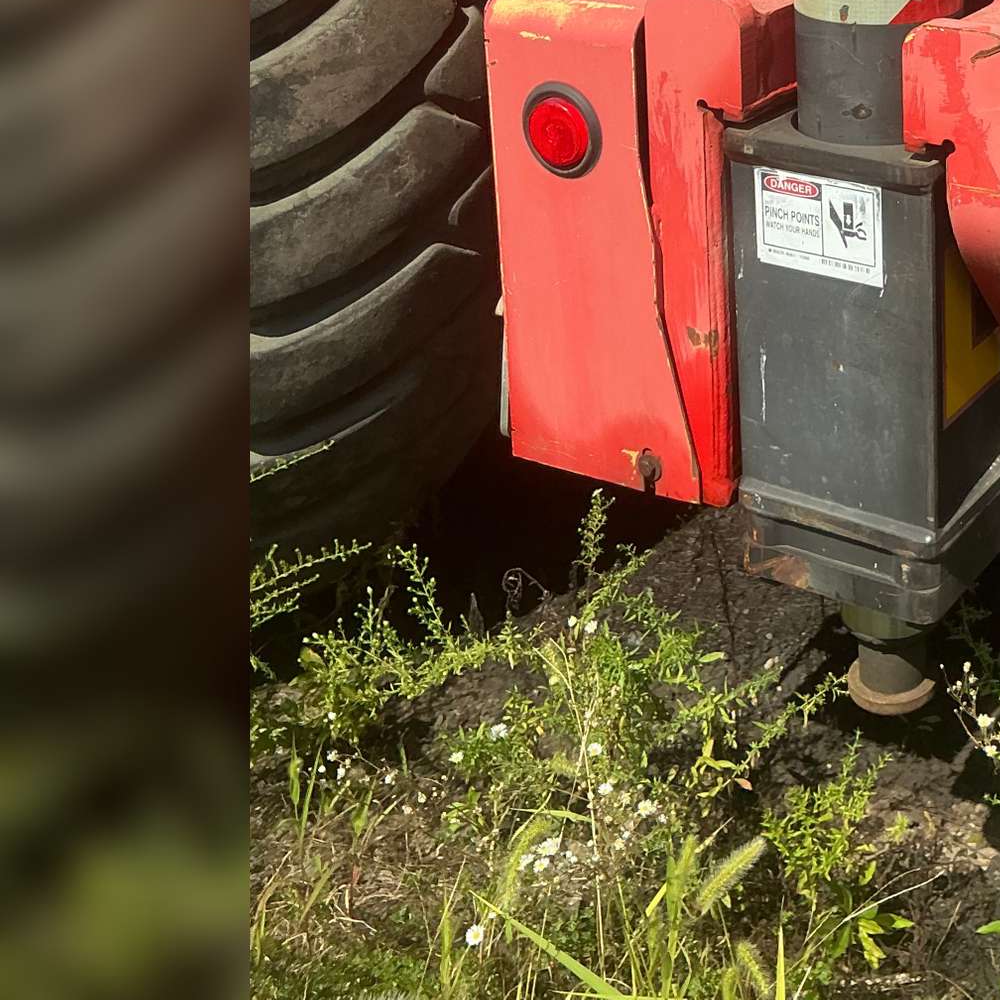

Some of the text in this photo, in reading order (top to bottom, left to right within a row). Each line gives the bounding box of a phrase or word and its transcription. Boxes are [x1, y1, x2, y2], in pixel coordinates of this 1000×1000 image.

[770, 177, 813, 196] DANGER
[765, 205, 821, 227] PINCH POINTS
[766, 222, 821, 238] WATCH YOUR HANDS
